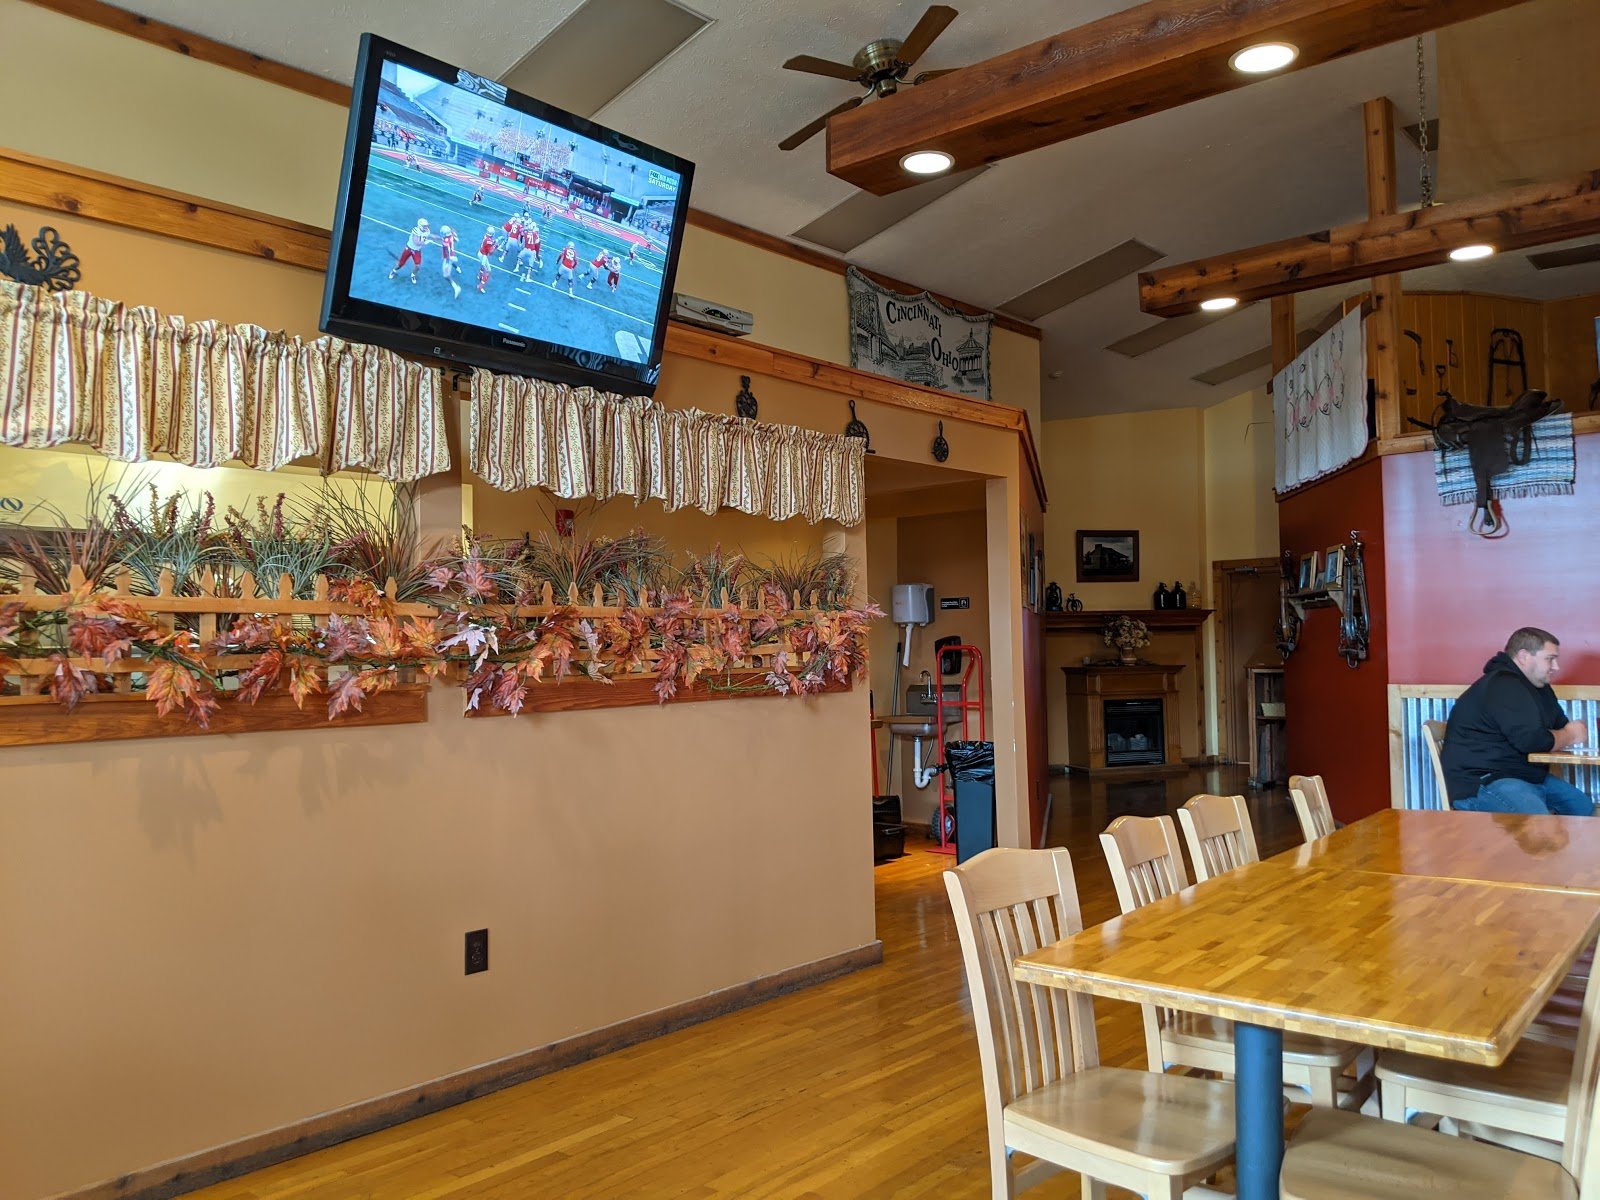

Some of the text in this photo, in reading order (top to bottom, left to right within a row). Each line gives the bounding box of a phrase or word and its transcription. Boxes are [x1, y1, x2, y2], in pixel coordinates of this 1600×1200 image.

[648, 177, 677, 192] SATURDAY
[526, 234, 534, 245] 71
[502, 337, 526, 348] Panasonic
